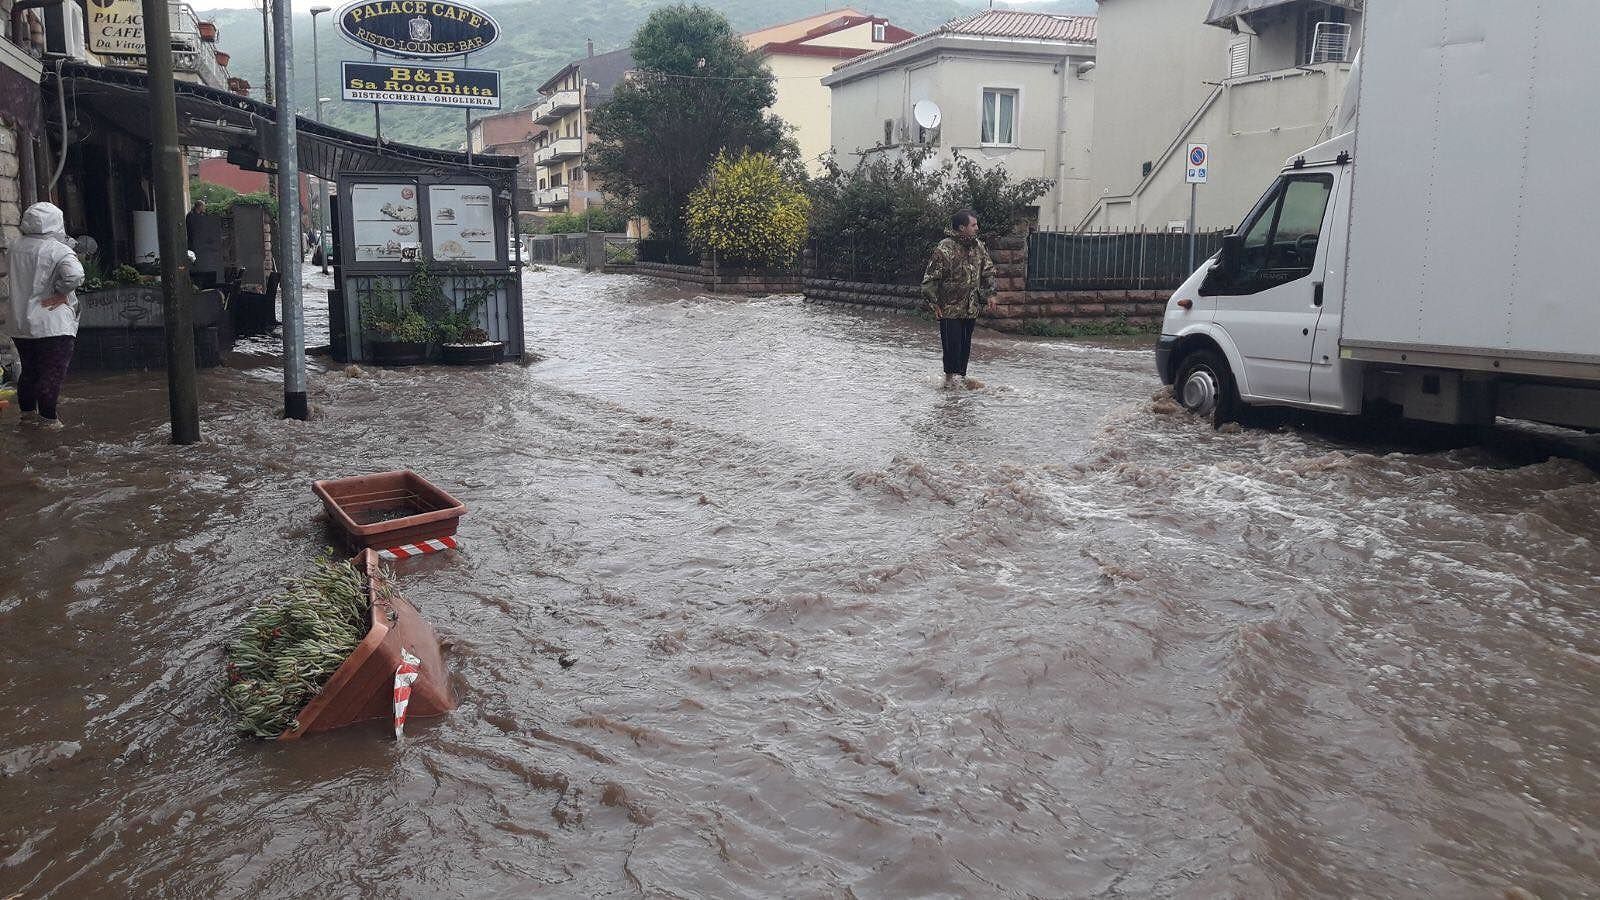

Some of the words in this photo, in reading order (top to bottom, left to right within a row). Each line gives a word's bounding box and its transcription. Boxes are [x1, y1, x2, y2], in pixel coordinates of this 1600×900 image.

[94, 12, 144, 25] PALAC
[351, 1, 428, 23] PALACE
[432, 1, 488, 29] CAFE'
[96, 39, 111, 48] Da
[350, 78, 378, 90] Sa
[384, 80, 494, 97] Rocchitta
[351, 91, 427, 102] BISTECCHERIA
[434, 95, 493, 106] GRIGLIERIA
